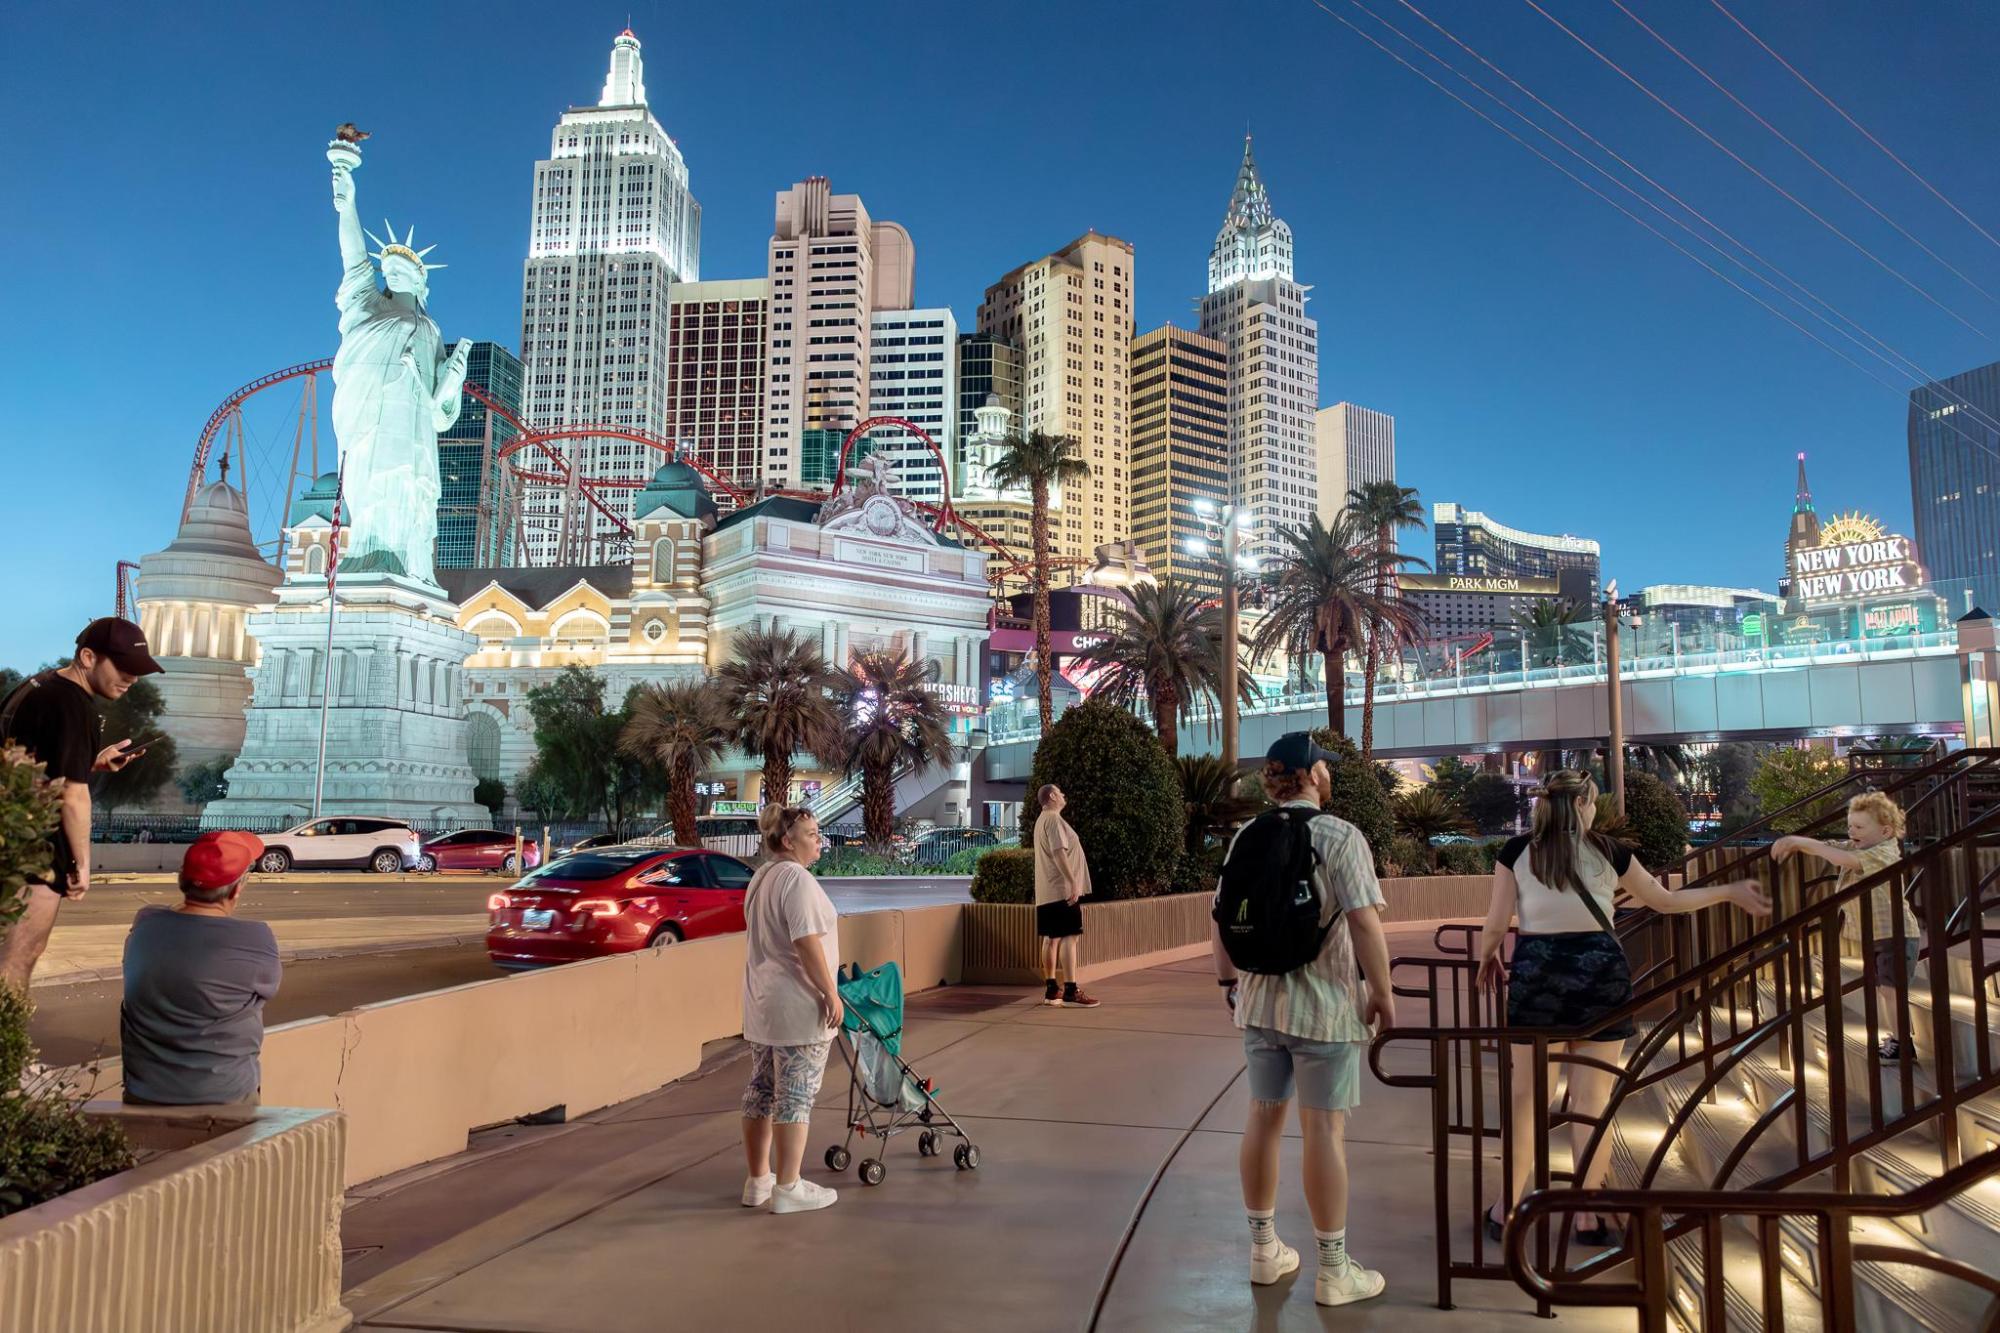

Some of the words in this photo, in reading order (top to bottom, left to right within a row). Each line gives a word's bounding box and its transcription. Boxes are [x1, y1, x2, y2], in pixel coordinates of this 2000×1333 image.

[1797, 547, 1841, 573] NEW
[1845, 539, 1903, 566] YORK
[1450, 577, 1482, 590] PARK
[1485, 578, 1519, 591] MGM
[1798, 572, 1843, 600] NEW
[1847, 565, 1906, 592] YORK
